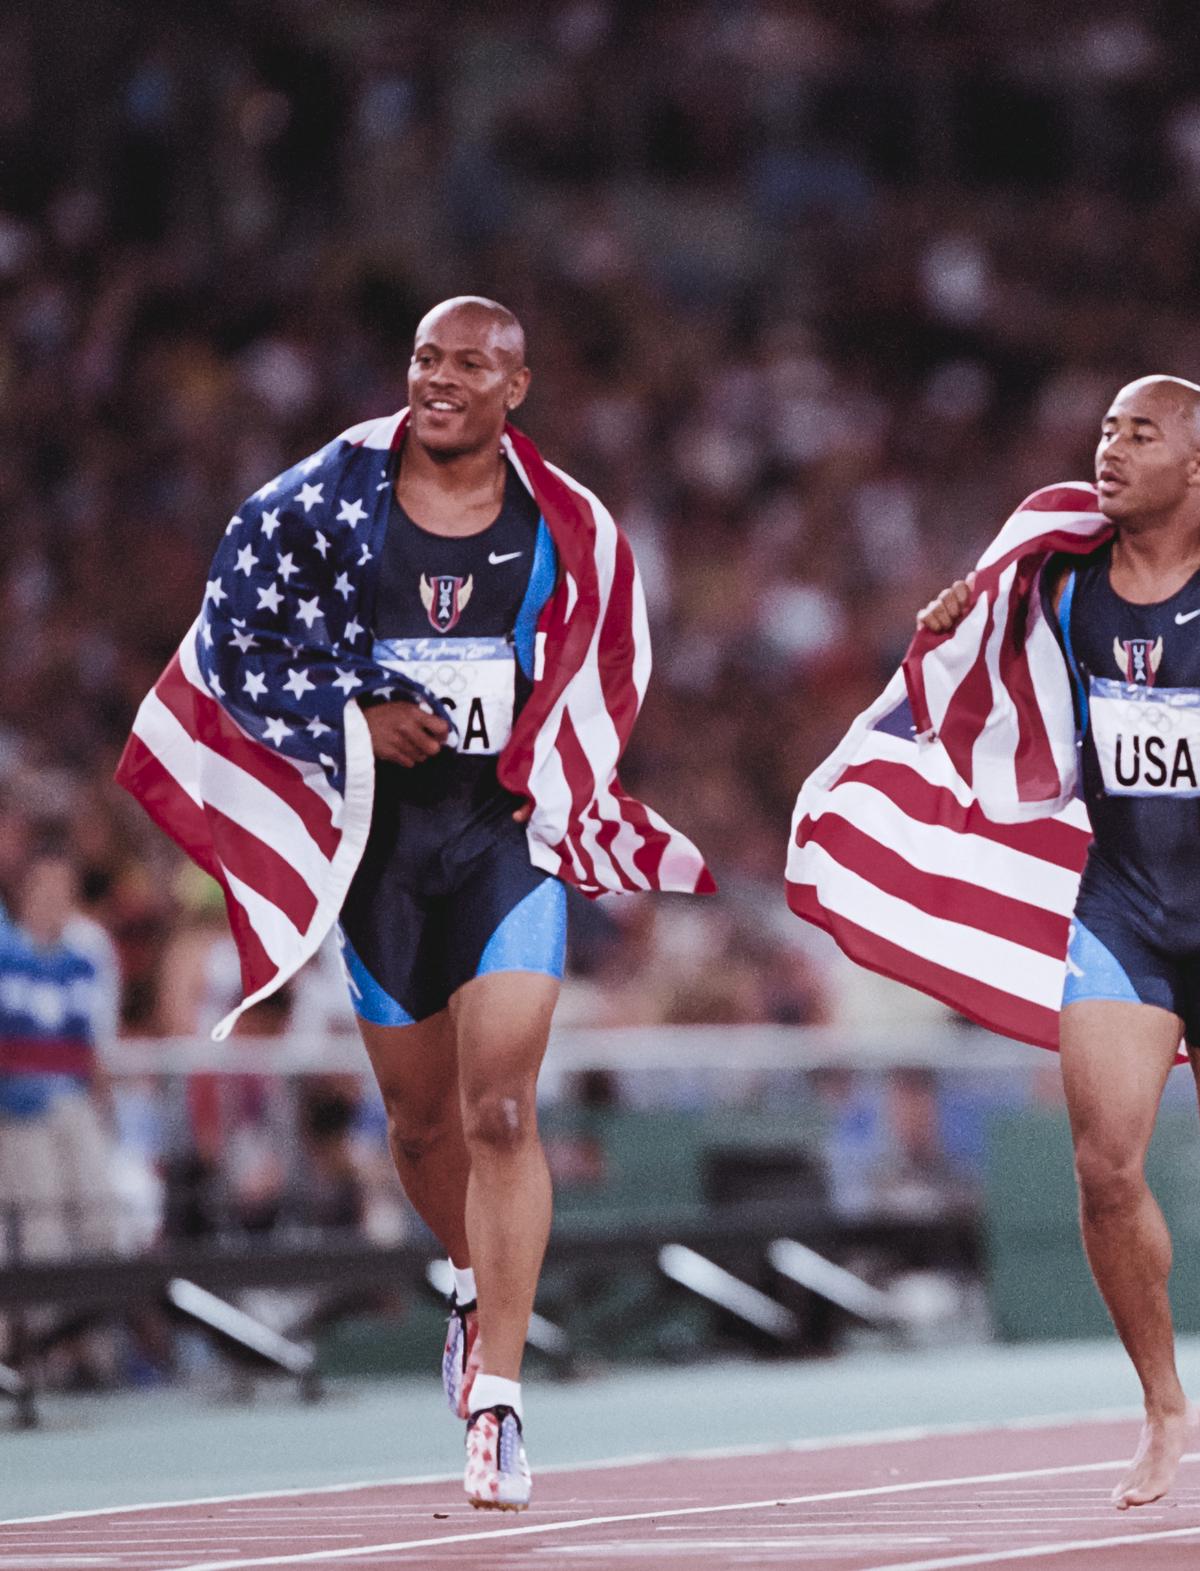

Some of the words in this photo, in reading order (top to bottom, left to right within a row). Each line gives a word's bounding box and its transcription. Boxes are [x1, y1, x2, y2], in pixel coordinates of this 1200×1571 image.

[438, 580, 452, 619] USA
[1132, 644, 1146, 681] USA
[1115, 734, 1198, 788] USA
